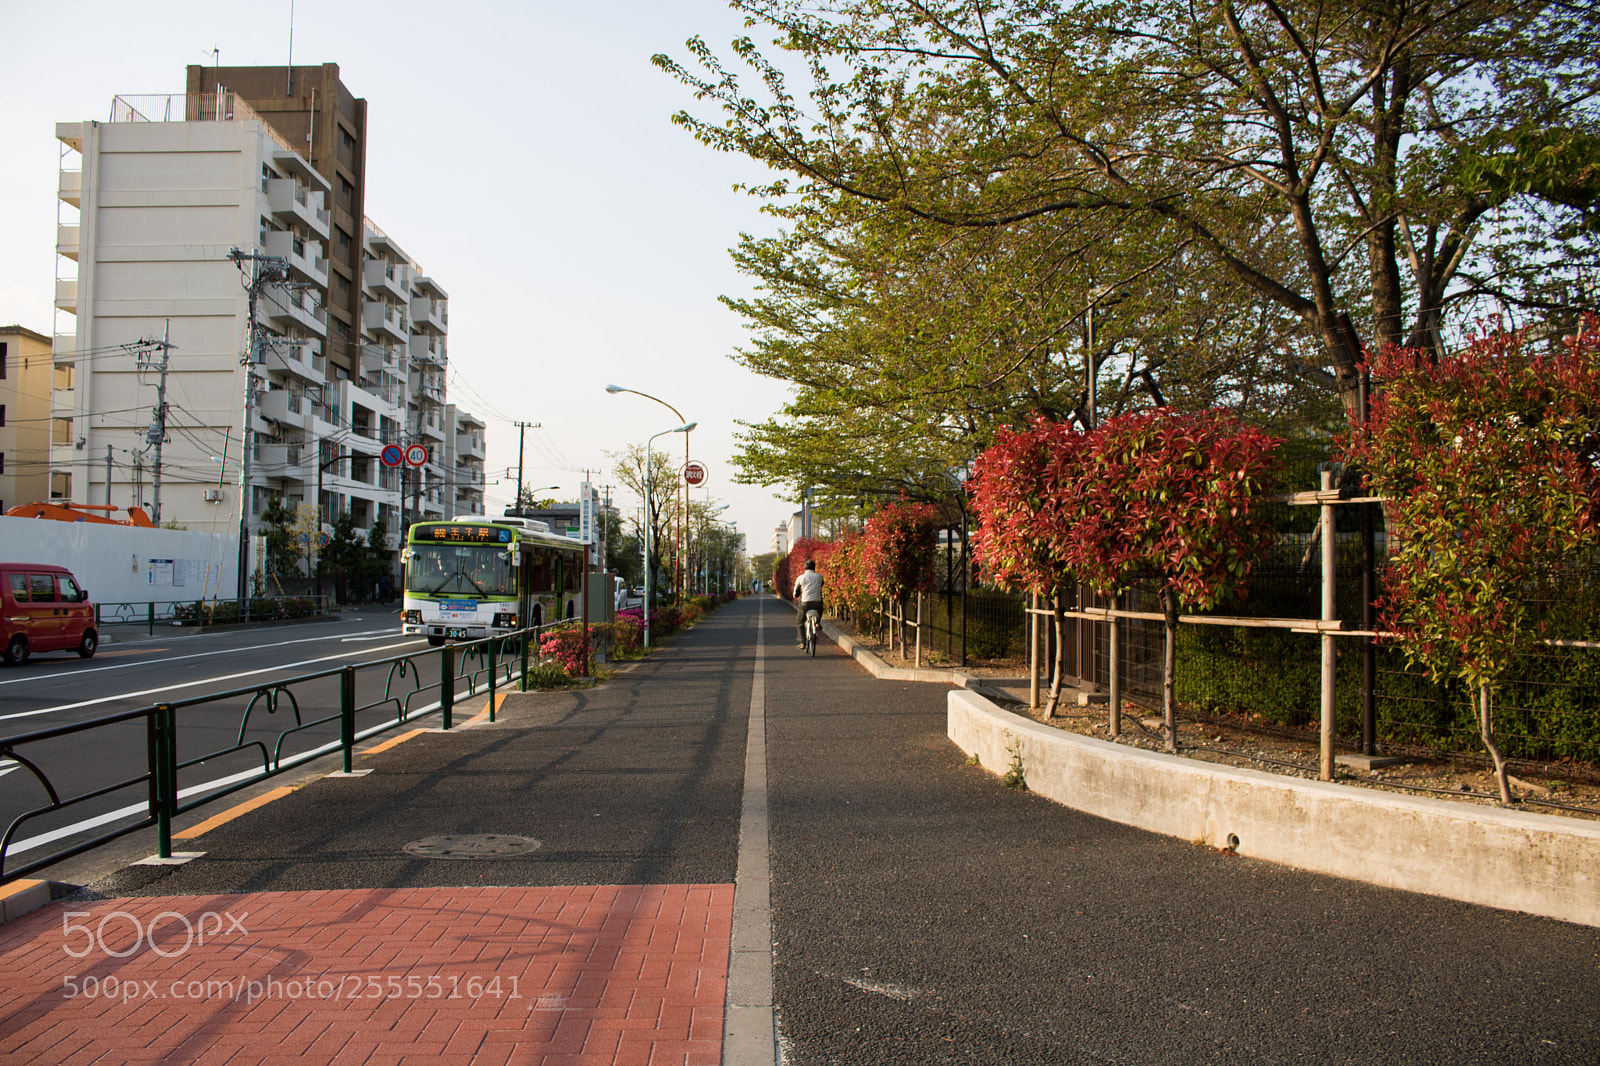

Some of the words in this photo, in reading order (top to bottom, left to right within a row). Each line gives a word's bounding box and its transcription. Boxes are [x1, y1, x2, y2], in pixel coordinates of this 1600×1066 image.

[410, 450, 423, 461] 40
[450, 527, 490, 537] 王子駅
